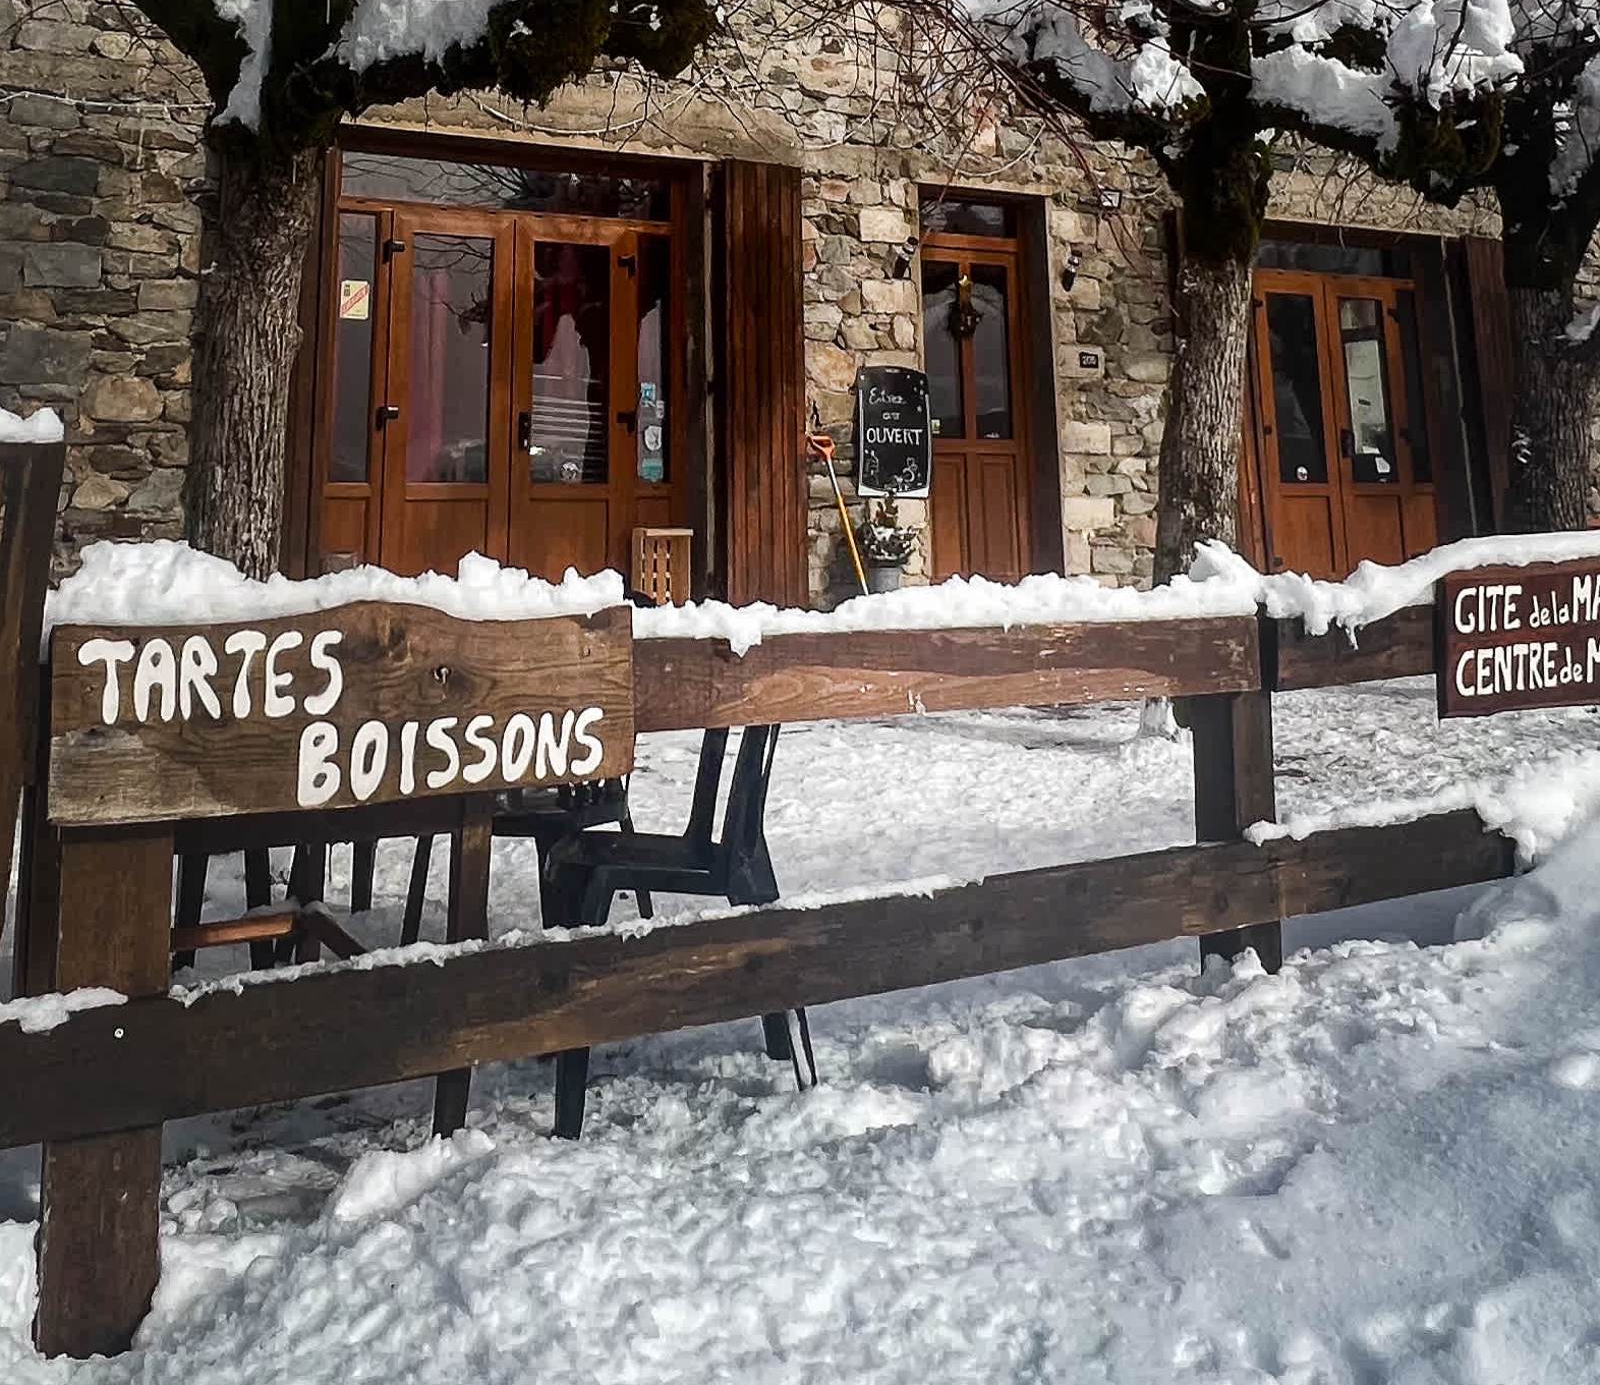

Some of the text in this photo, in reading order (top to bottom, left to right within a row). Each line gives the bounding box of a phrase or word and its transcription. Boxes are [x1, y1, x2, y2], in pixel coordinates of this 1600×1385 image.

[866, 427, 923, 445] OUVERT
[1455, 585, 1522, 634] GITE
[78, 630, 343, 725] TARTES
[1455, 642, 1558, 697] CENTRE
[1559, 646, 1583, 684] de
[297, 707, 605, 807] BOISSONS
